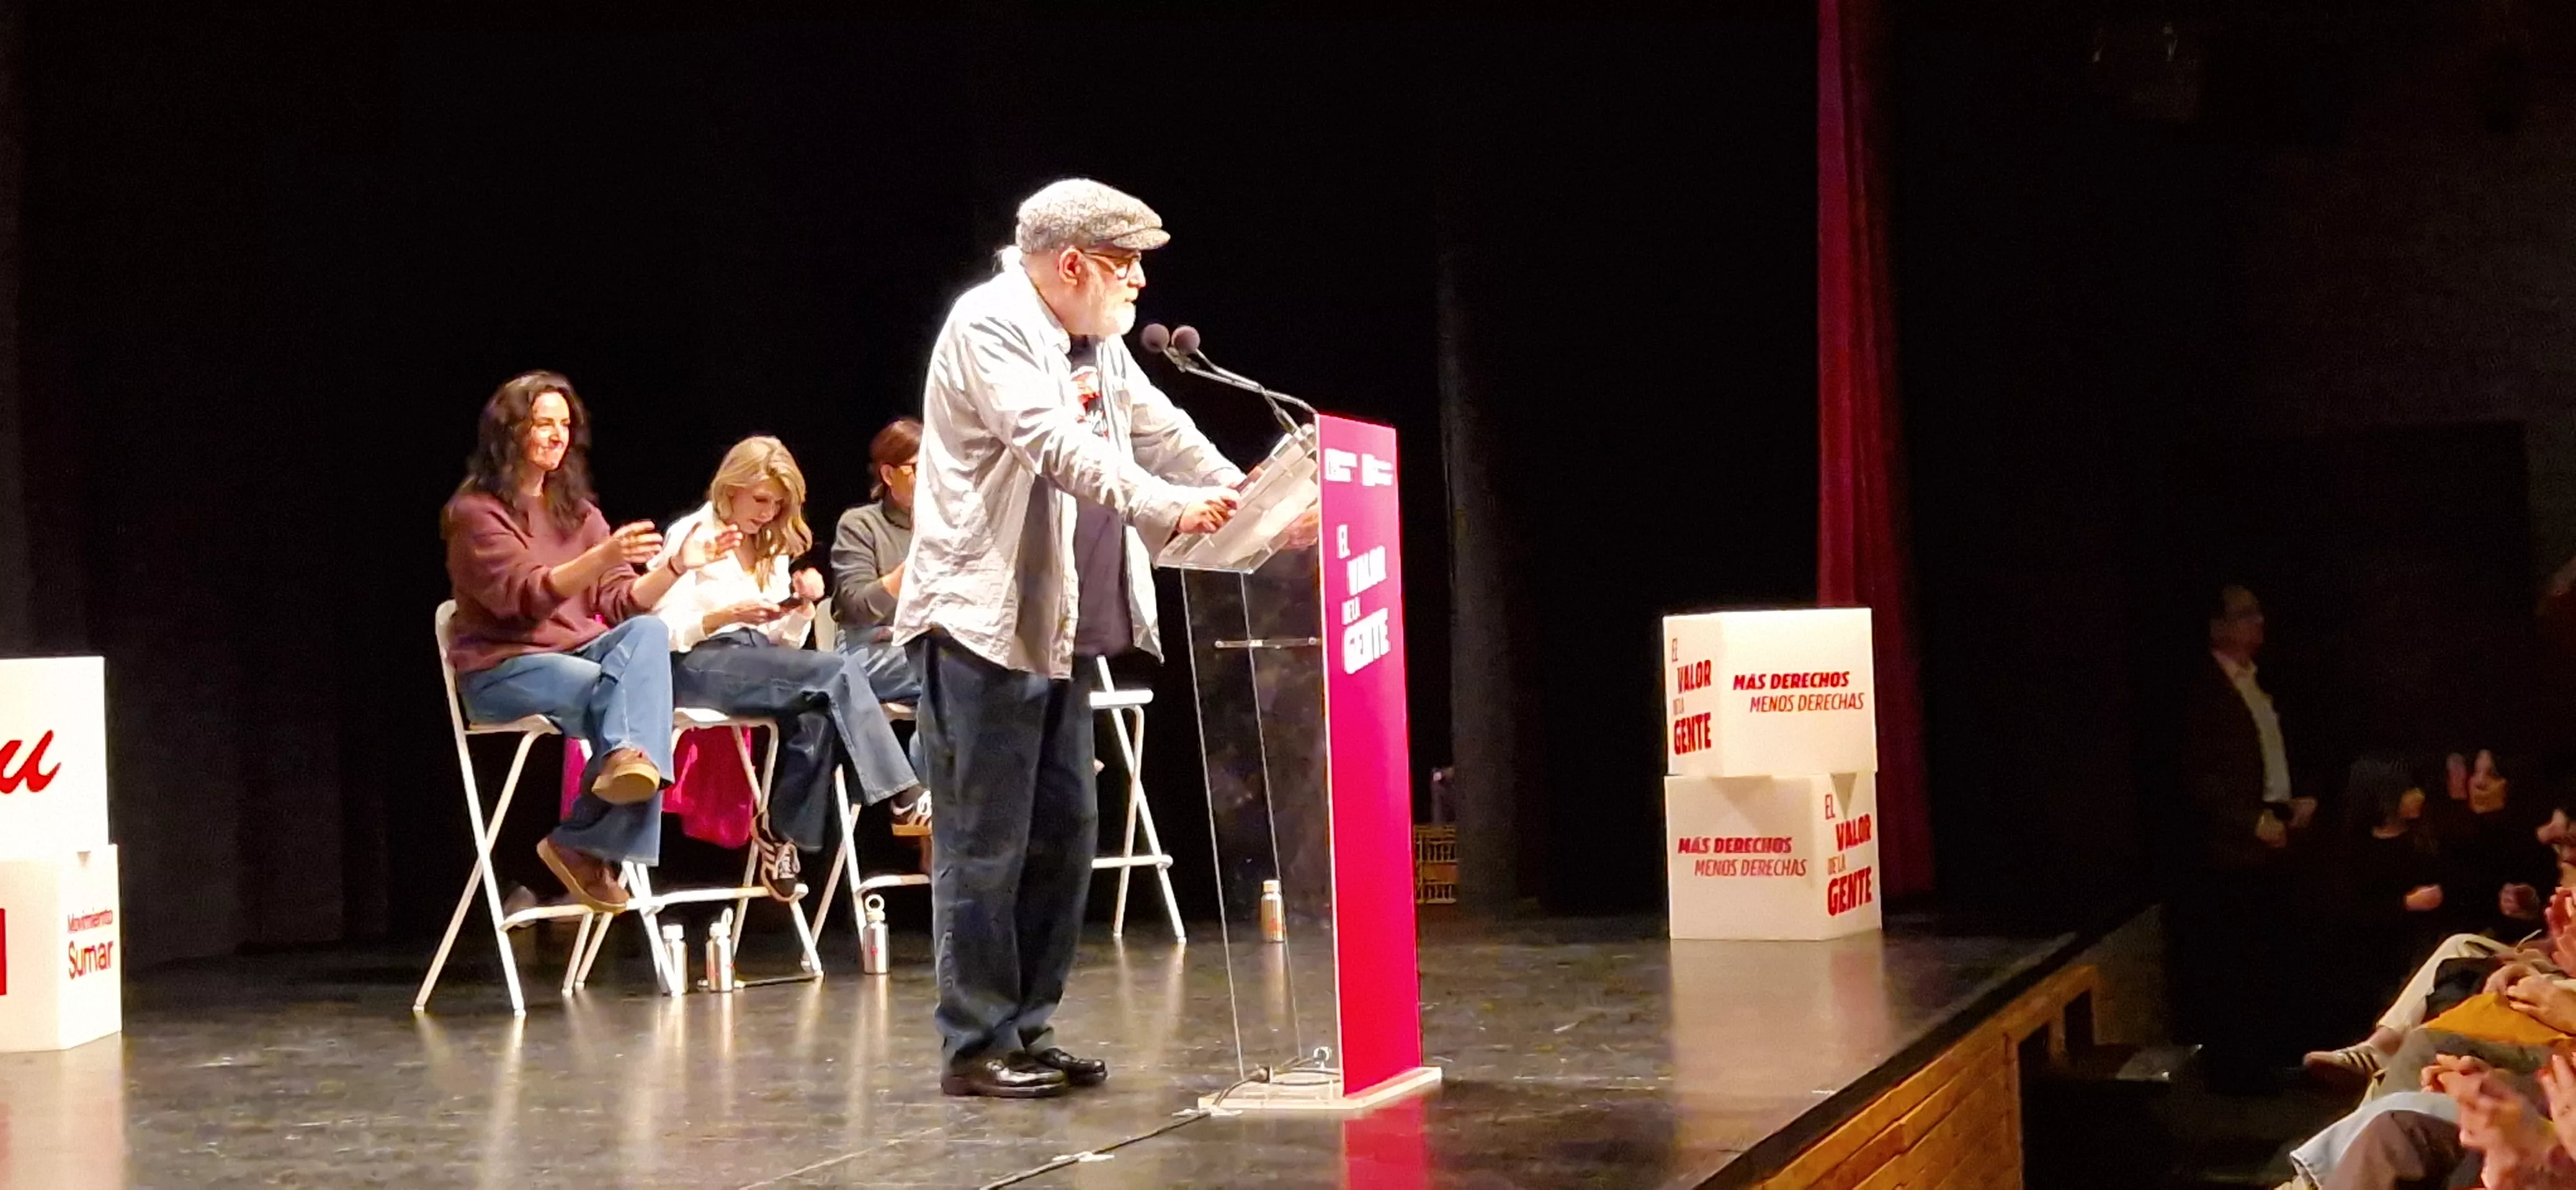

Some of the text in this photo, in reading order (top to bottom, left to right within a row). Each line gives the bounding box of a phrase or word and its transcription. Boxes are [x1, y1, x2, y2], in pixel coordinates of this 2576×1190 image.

[1677, 659, 1711, 694] VALOR
[1770, 671, 1850, 689] DERECHOS
[1750, 692, 1864, 713] MENOS DERECHAS
[1674, 712, 1711, 755] GENTE
[1825, 794, 1835, 820] EL
[1714, 837, 1792, 853] DERECHOS
[1835, 814, 1871, 851] VALOR
[1694, 858, 1807, 876] MENOS DERECHAS
[1828, 865, 1872, 916] GENTE
[68, 940, 114, 979] Sumar
